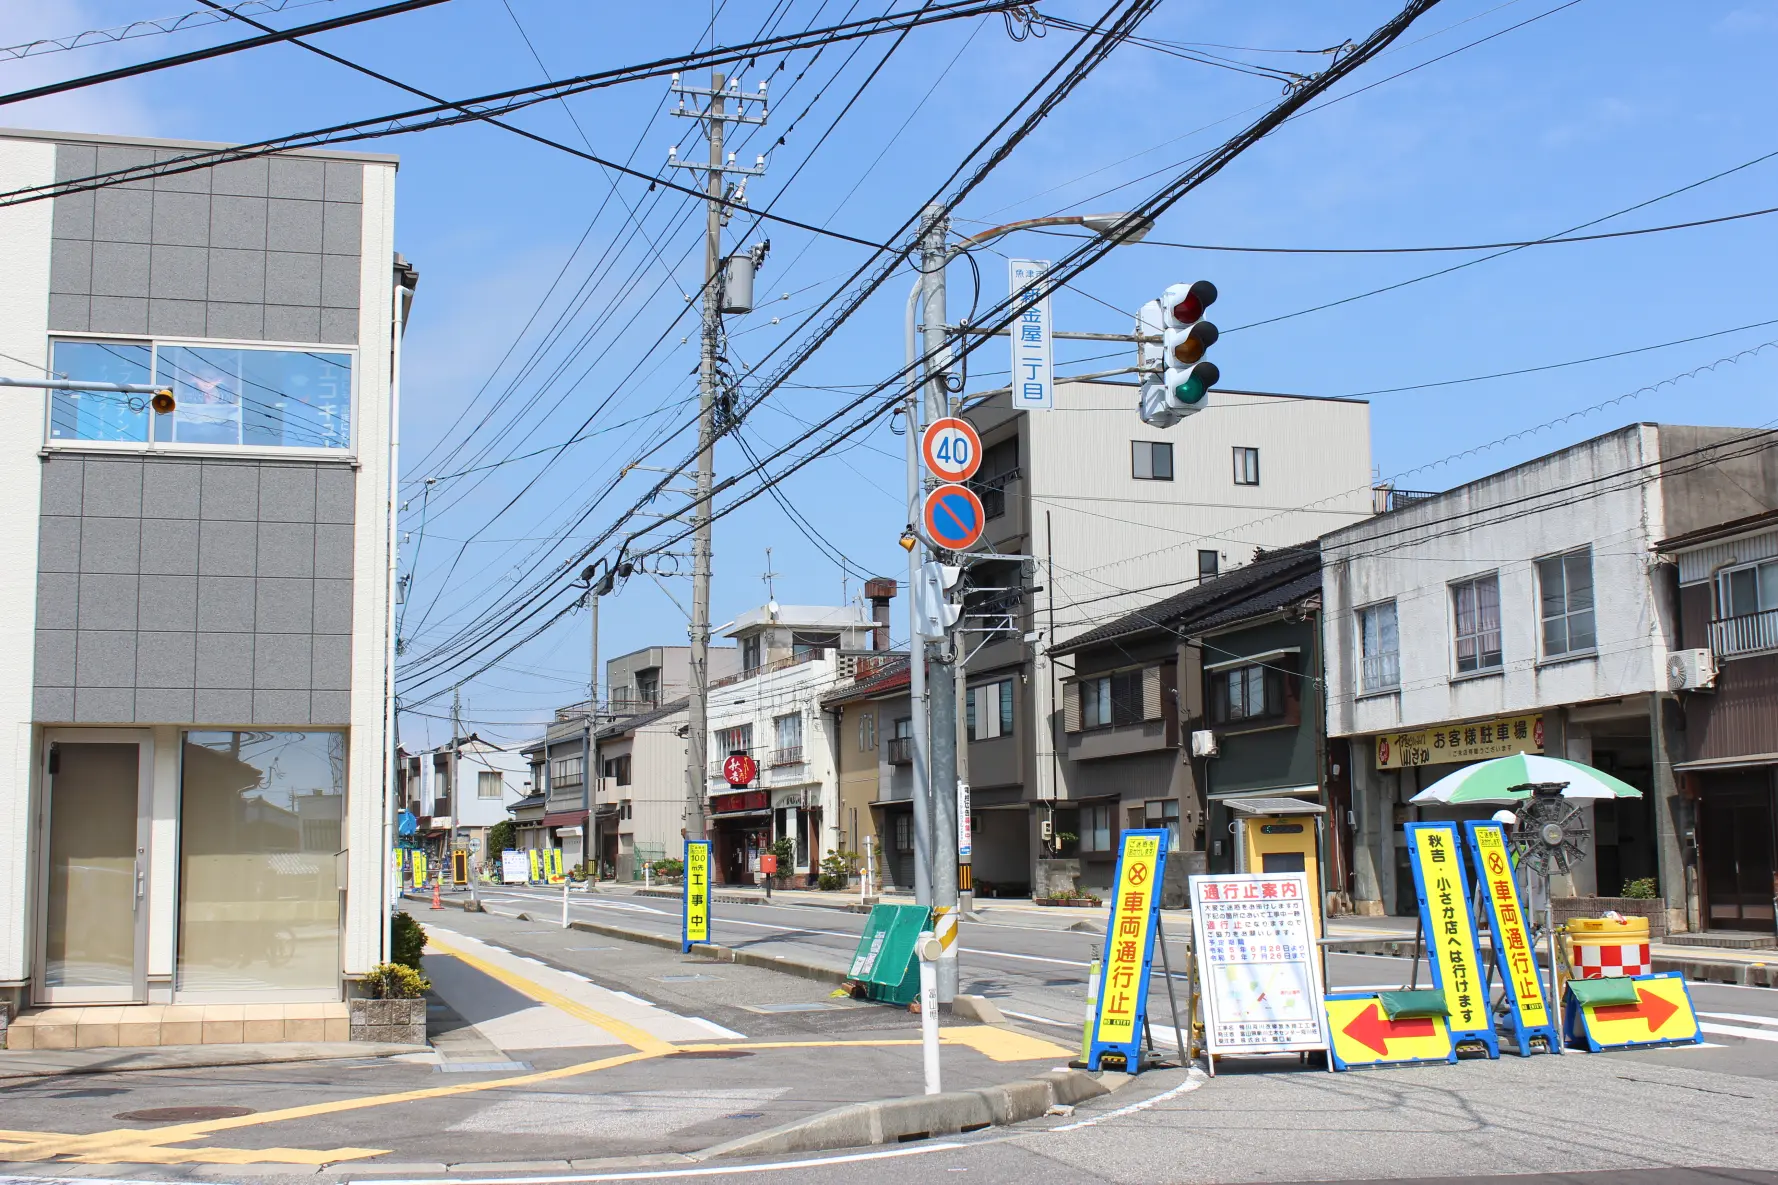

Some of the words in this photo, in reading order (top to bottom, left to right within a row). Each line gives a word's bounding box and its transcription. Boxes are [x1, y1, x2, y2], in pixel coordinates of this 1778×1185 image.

[1015, 269, 1044, 278] 魚津市
[936, 437, 968, 465] 40
[1433, 720, 1527, 749] お客様駐車場
[691, 854, 706, 862] 100
[691, 874, 704, 927] 工事中
[1204, 882, 1297, 900] 通行止案内
[1107, 891, 1145, 1014] 車両通行止
[1493, 880, 1537, 999] 車両通行止
